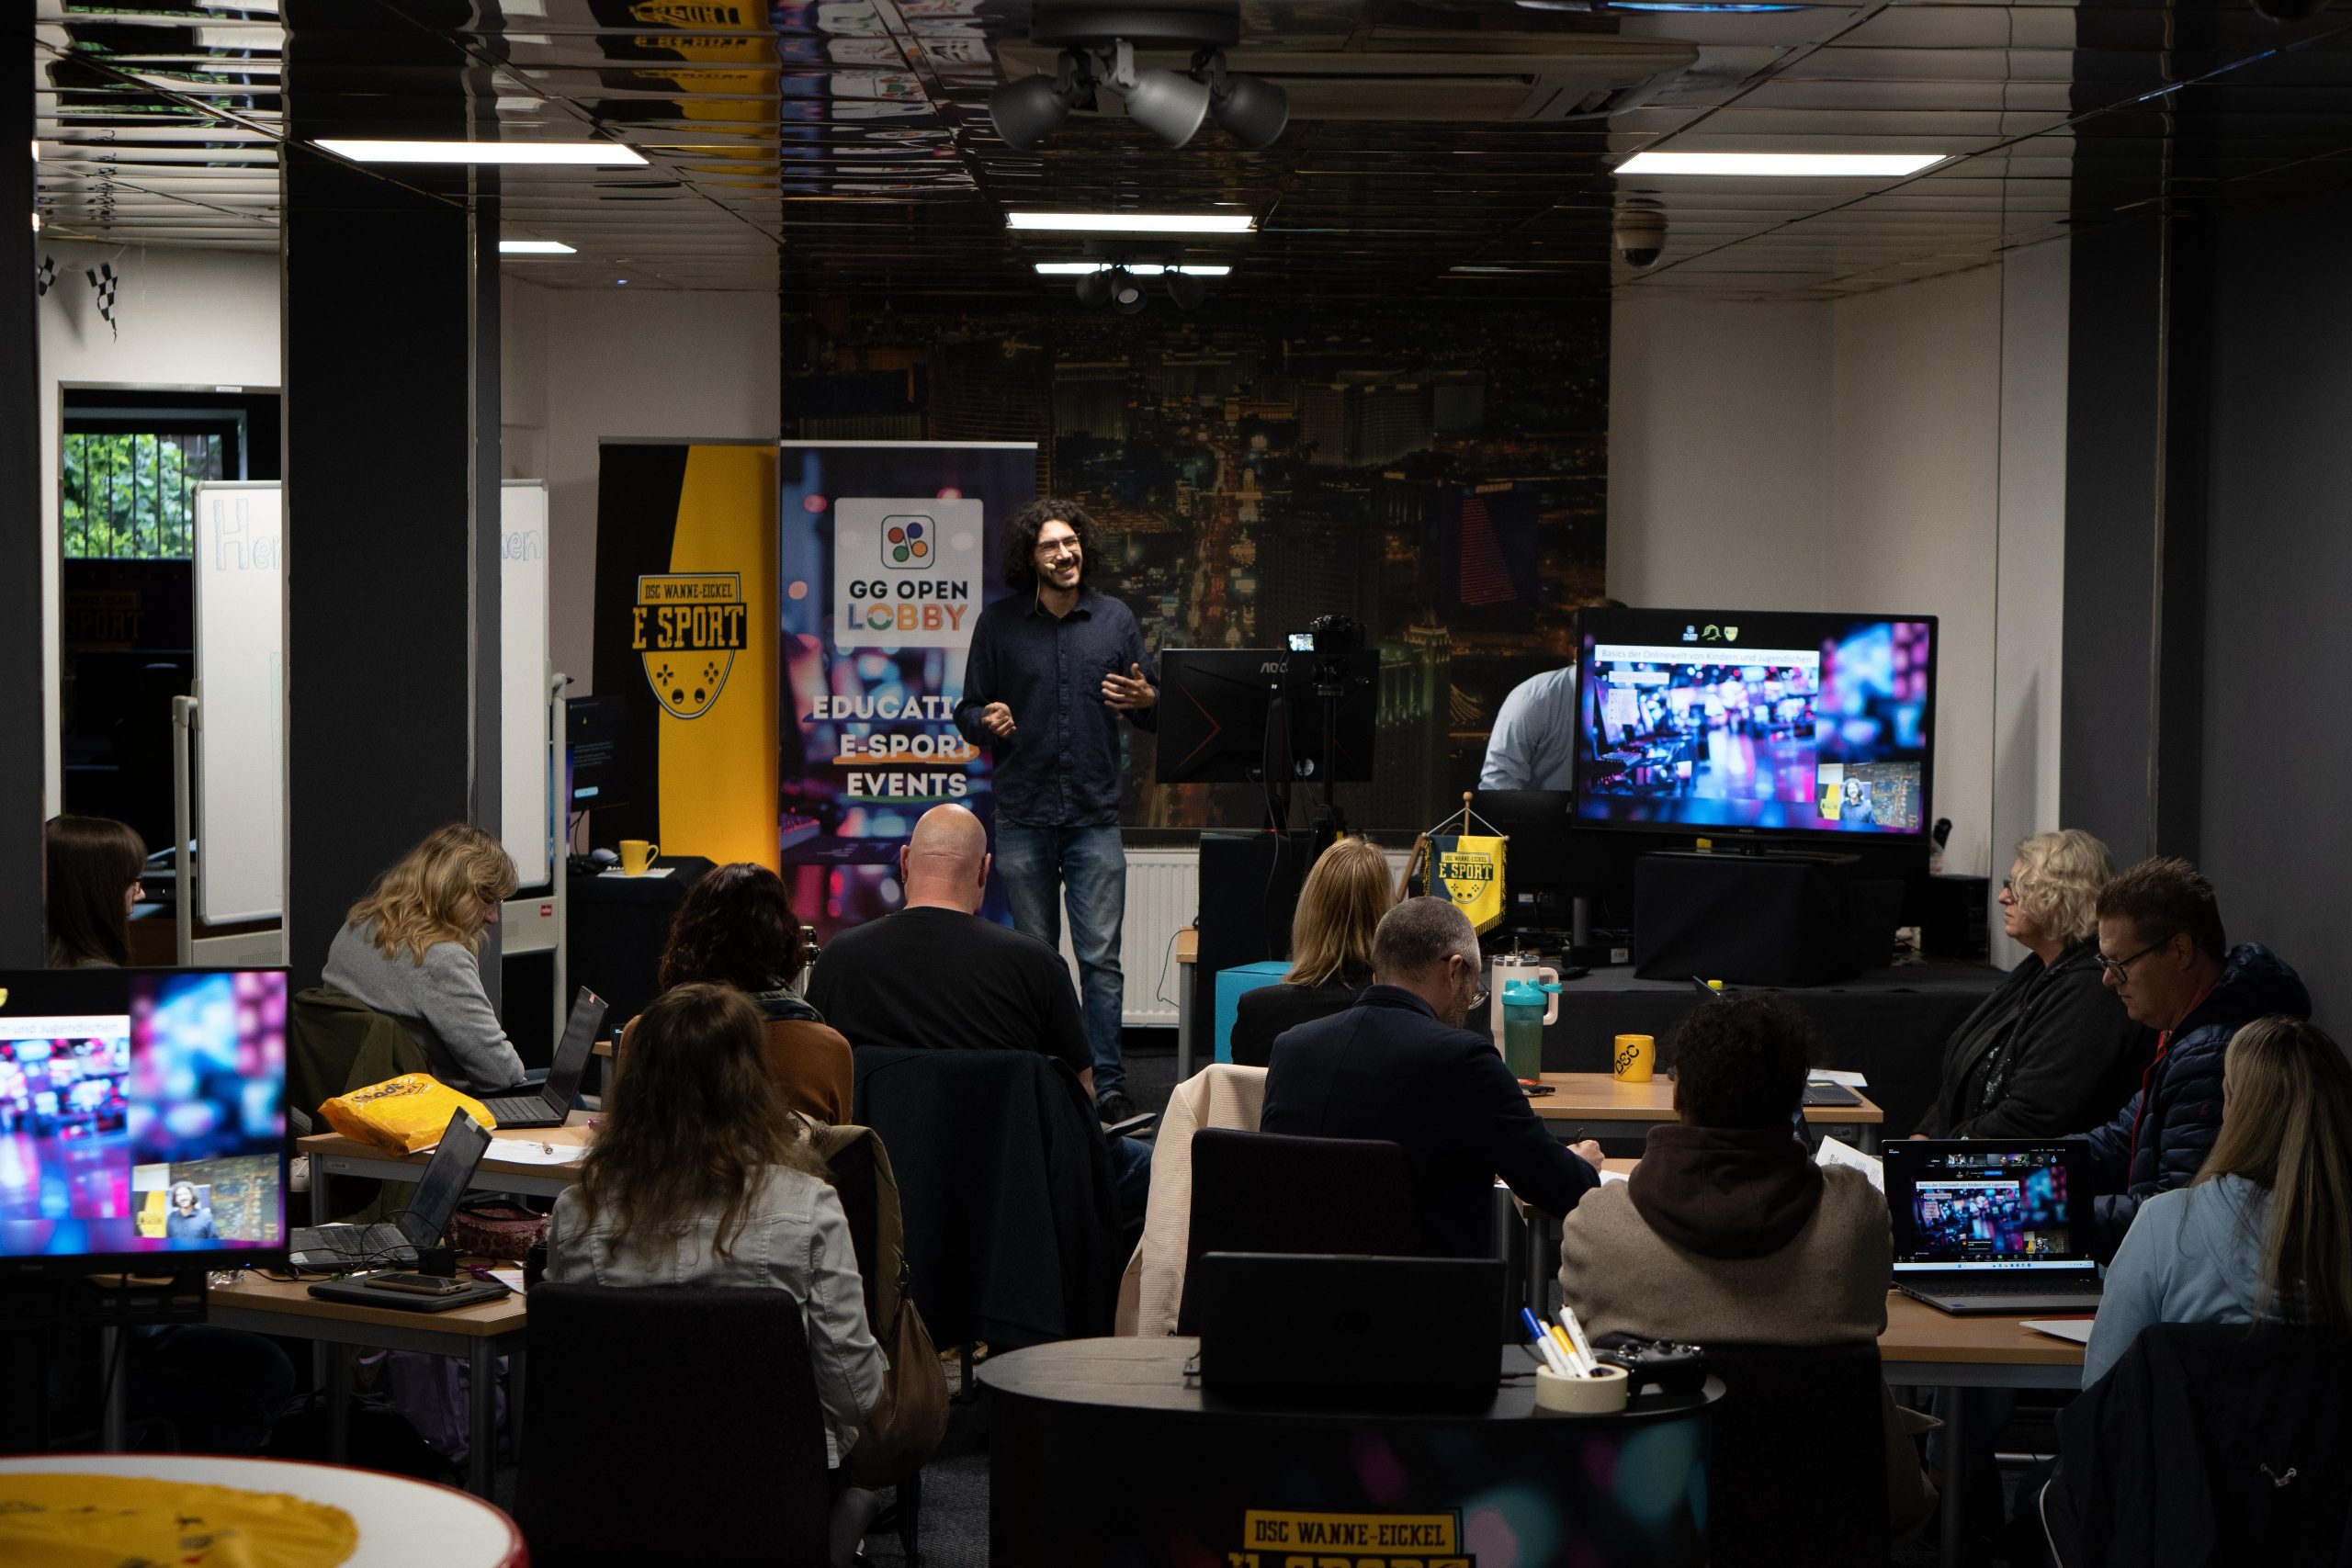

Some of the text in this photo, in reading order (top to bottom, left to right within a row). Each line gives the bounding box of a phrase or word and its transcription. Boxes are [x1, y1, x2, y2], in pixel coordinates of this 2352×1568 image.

[645, 583, 733, 599] DSC WANNE-EICKEL
[849, 580, 968, 600] GG OPEN
[632, 605, 744, 649] E SPORT
[847, 603, 968, 631] LOBBY
[1601, 649, 1626, 659] Basics
[1627, 649, 1642, 659] der
[1643, 649, 1688, 660] Onlinewelt
[1705, 651, 1738, 661] Kindern
[1740, 652, 1758, 662] und
[847, 773, 967, 796] EVENTS
[1439, 863, 1492, 880] E SPORT
[1255, 1519, 1446, 1547] DSC WANNE-EICKEL
